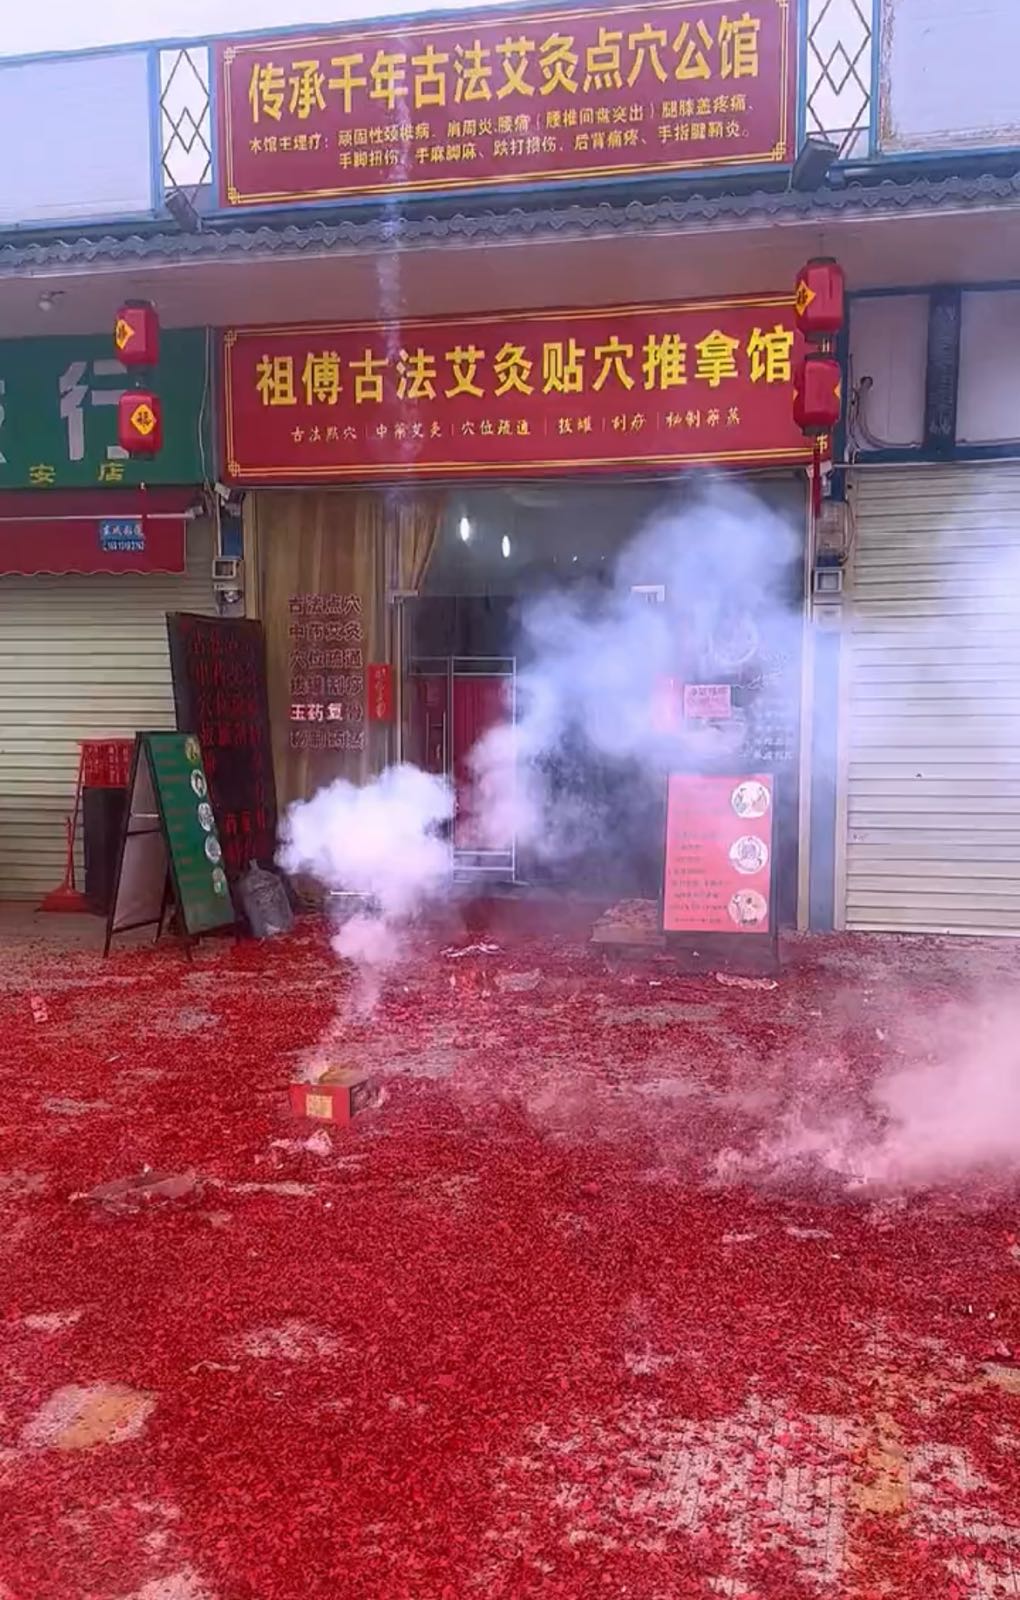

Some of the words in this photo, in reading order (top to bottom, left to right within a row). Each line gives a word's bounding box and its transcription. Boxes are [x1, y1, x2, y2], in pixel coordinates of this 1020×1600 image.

[248, 12, 760, 123] 传承千年古法艾灸点穴公馆
